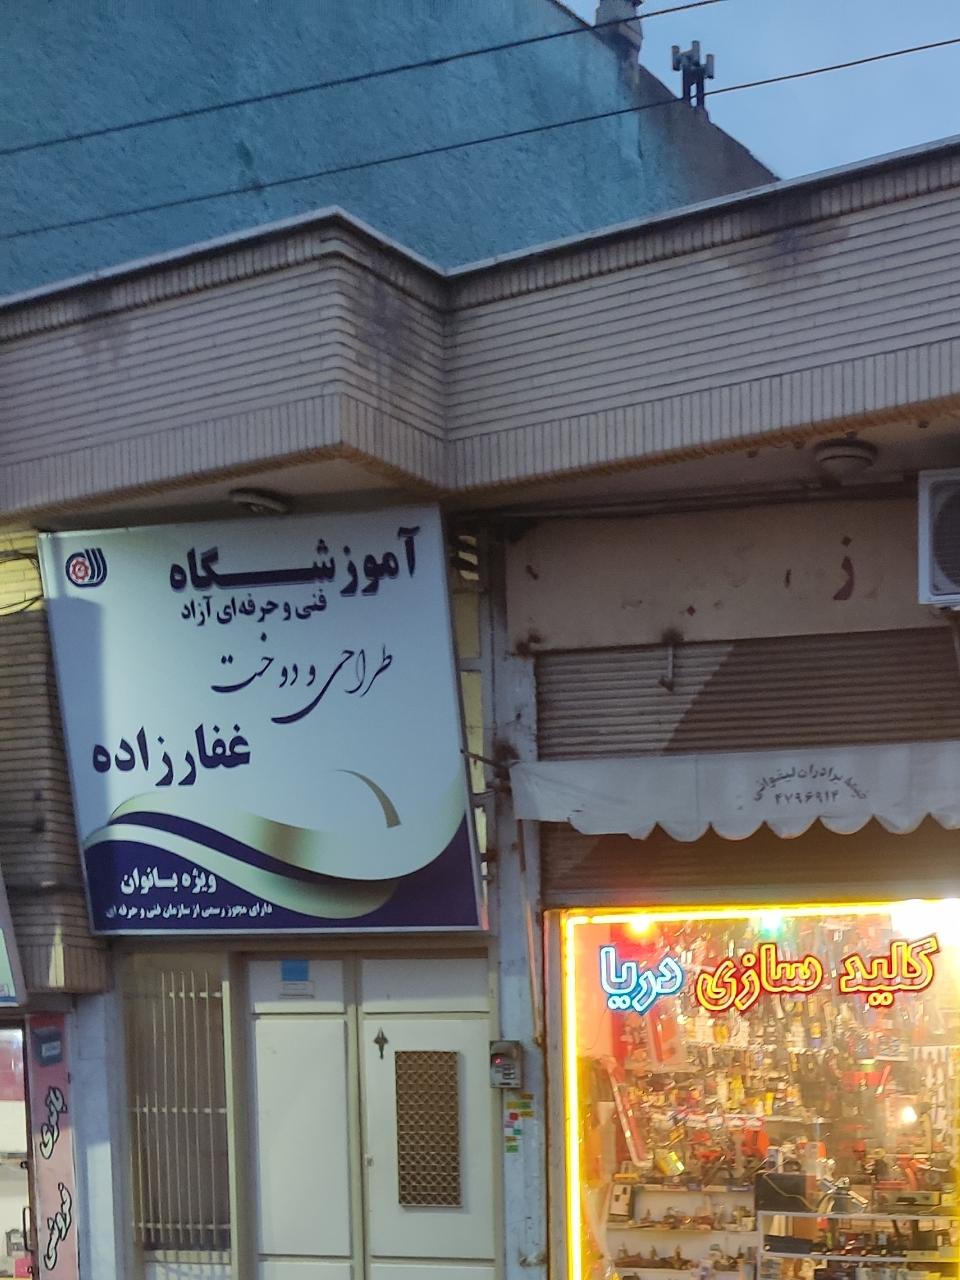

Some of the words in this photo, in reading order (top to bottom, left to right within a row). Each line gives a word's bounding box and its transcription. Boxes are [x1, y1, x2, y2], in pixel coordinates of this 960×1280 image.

[169, 526, 420, 596] آموزشگاه
[181, 595, 212, 626] آزاد
[283, 603, 292, 621] و
[295, 588, 328, 620] فنی
[211, 631, 299, 693] دوخت
[271, 643, 393, 724] طراحی
[120, 866, 179, 895] بانوان
[181, 867, 218, 894] ویژه
[599, 945, 685, 1015] دریا
[695, 941, 824, 1013] سازی
[839, 934, 941, 1007] کلید
